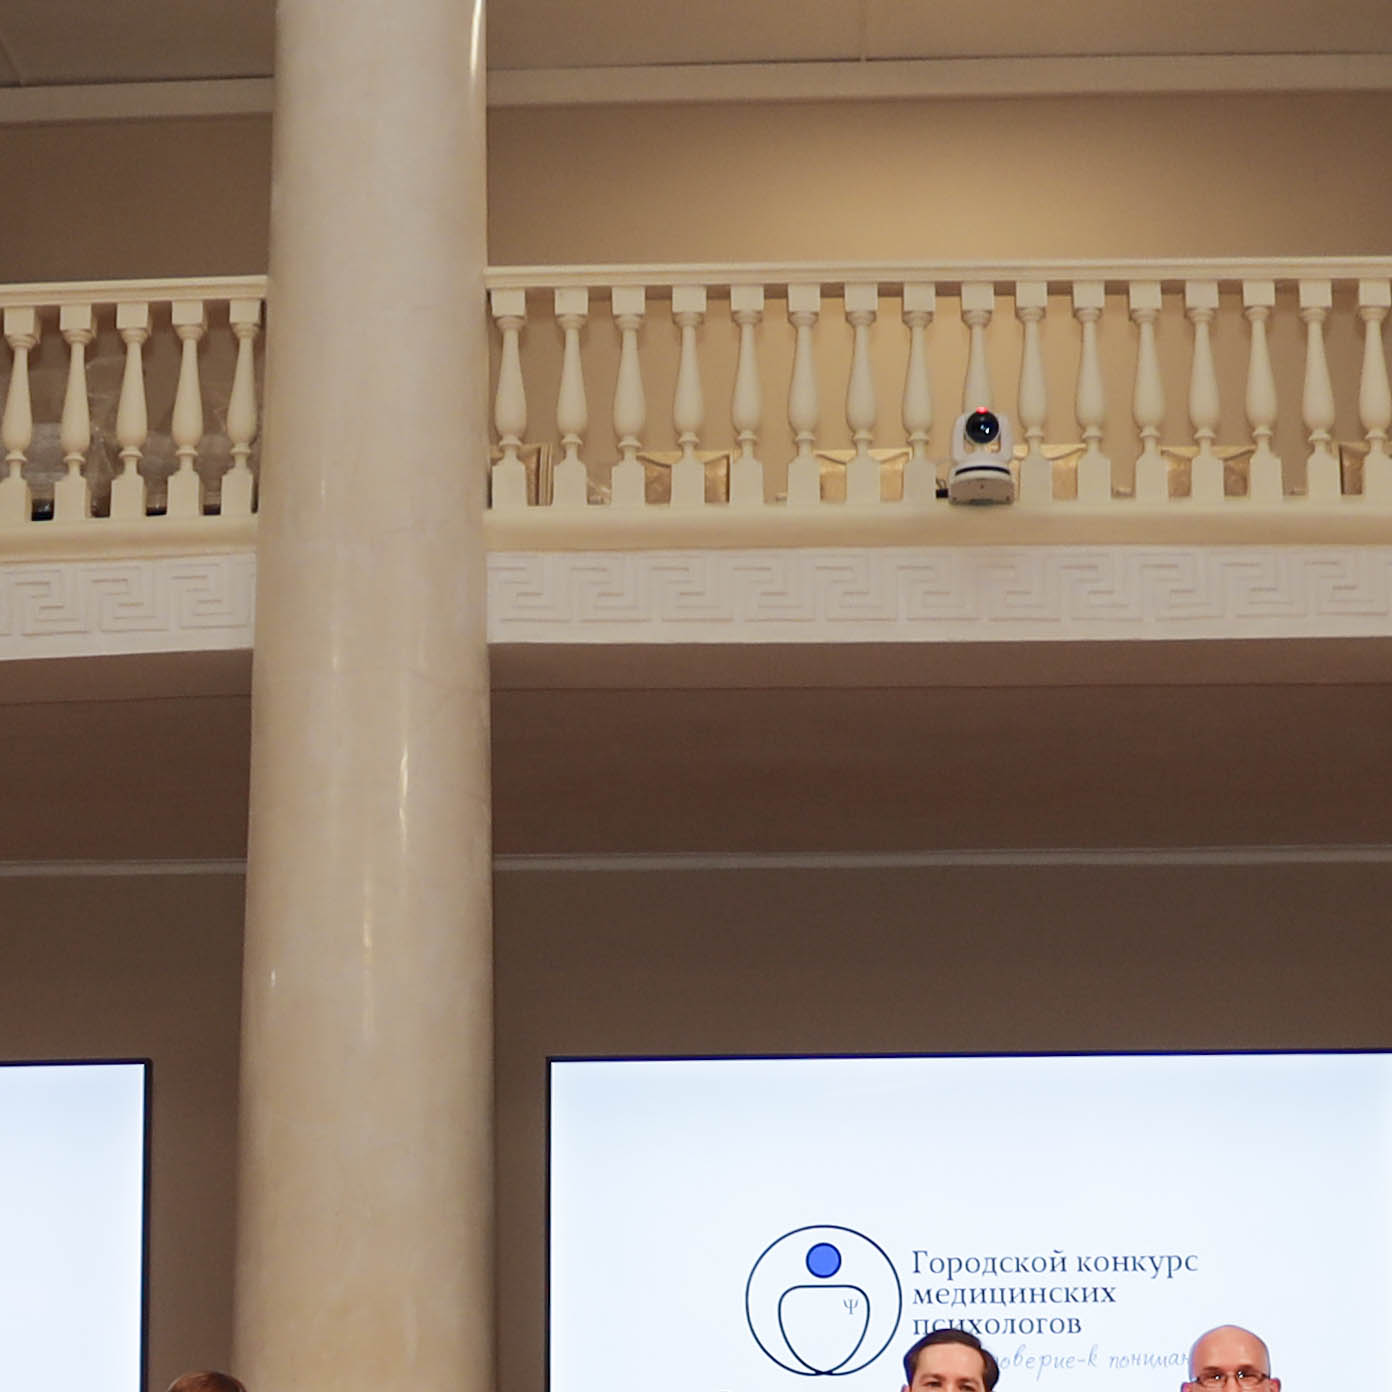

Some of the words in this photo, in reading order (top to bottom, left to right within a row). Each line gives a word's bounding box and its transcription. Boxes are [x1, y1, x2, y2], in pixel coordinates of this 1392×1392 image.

[912, 1249, 1068, 1281] Городской
[1077, 1254, 1199, 1280] конкурс
[912, 1286, 1117, 1308] медицинских
